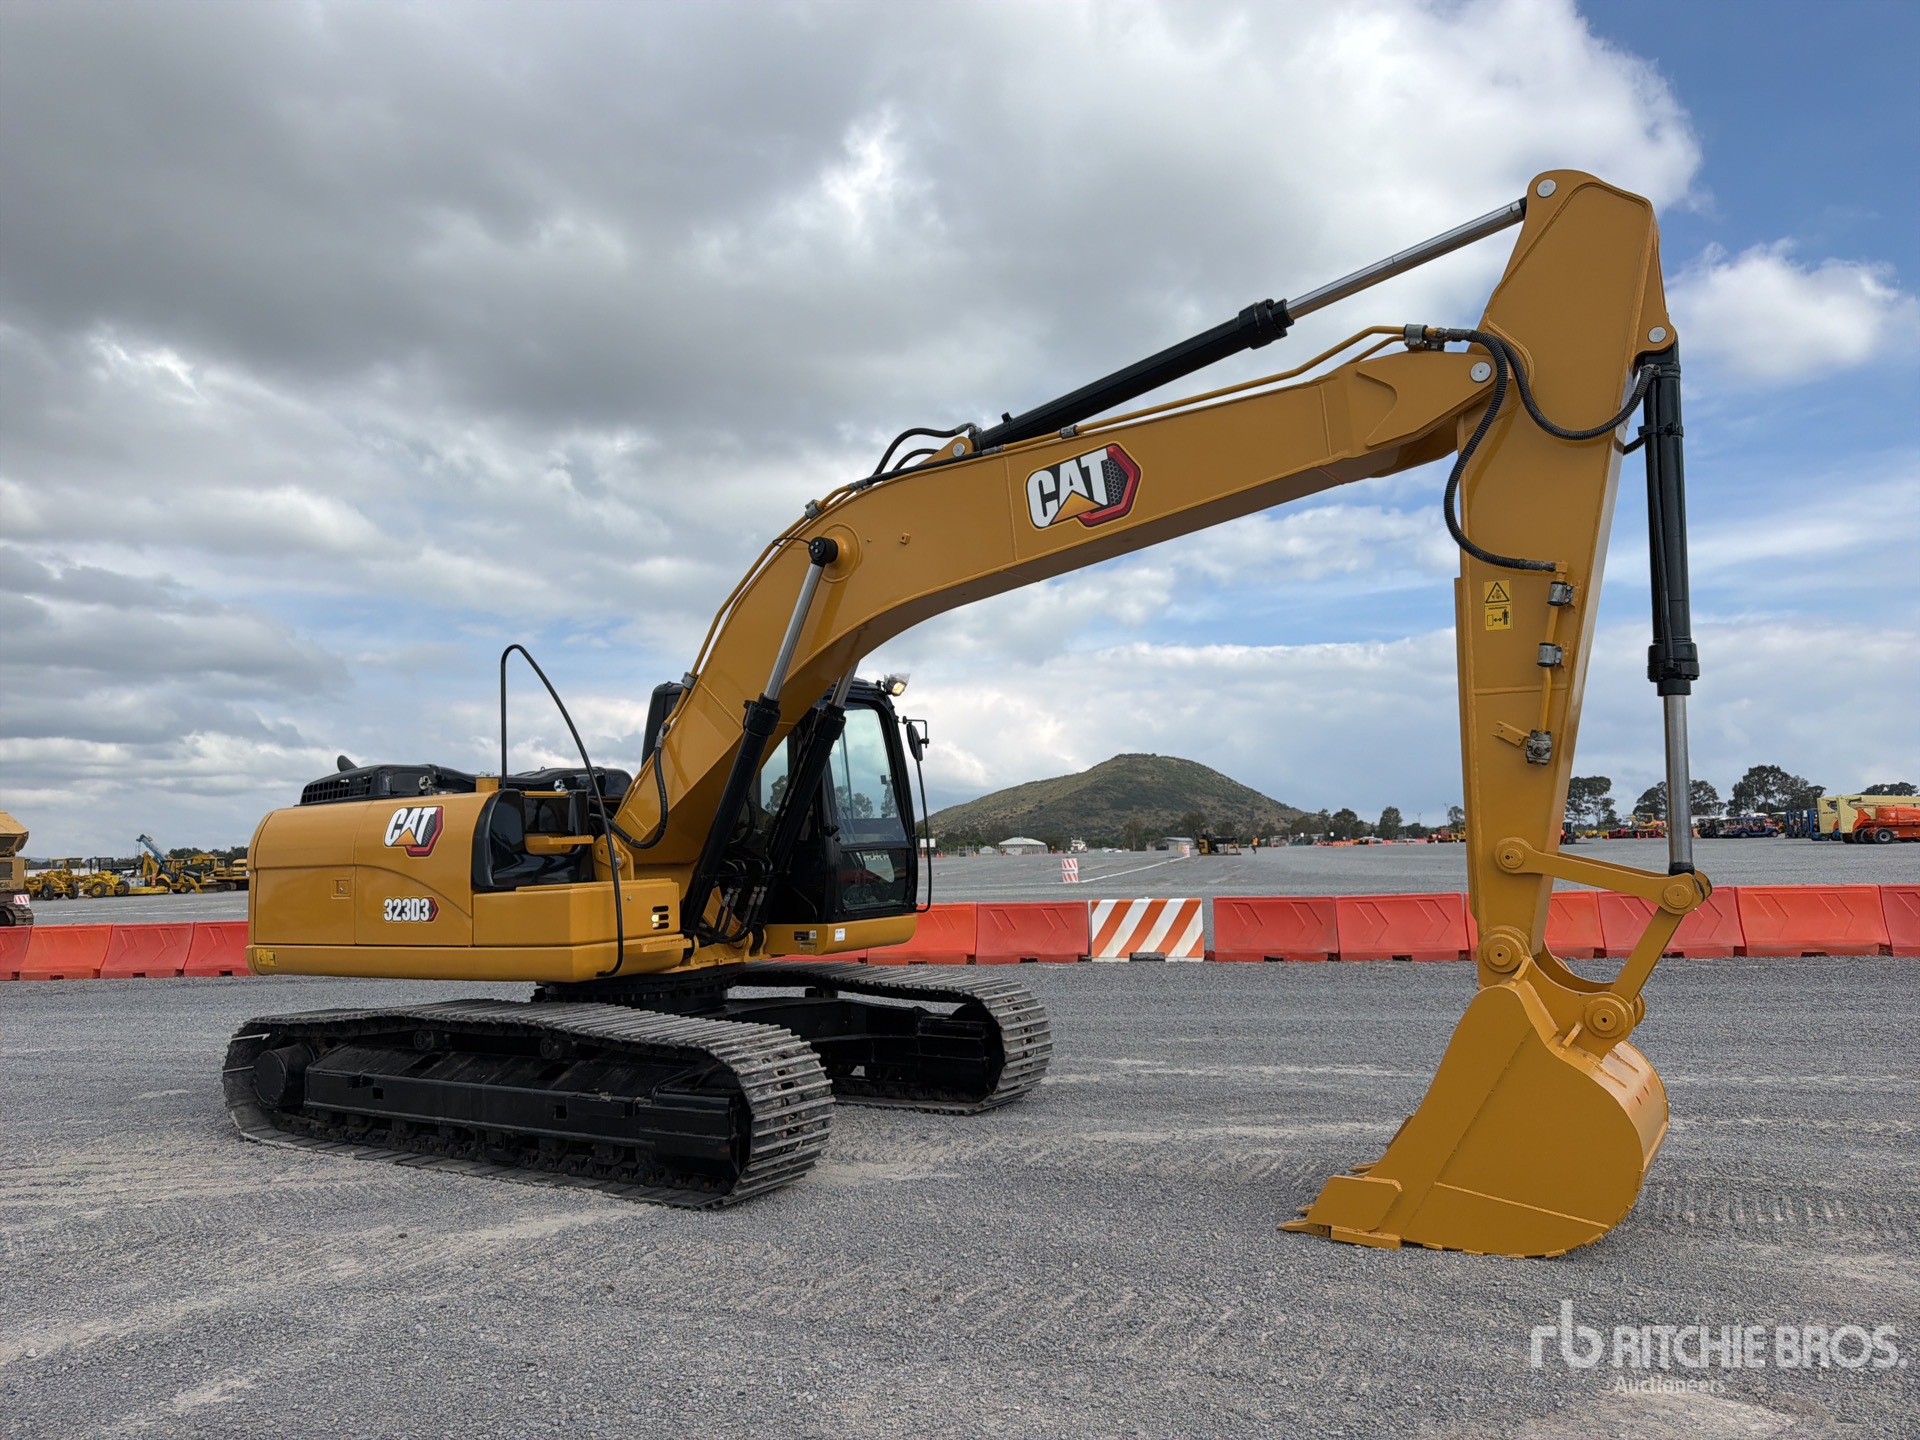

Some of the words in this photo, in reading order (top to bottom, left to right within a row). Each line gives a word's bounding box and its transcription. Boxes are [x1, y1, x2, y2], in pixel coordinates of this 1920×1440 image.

[1027, 447, 1109, 528] CAT
[384, 806, 438, 847] CAT
[384, 898, 430, 921] 323D3
